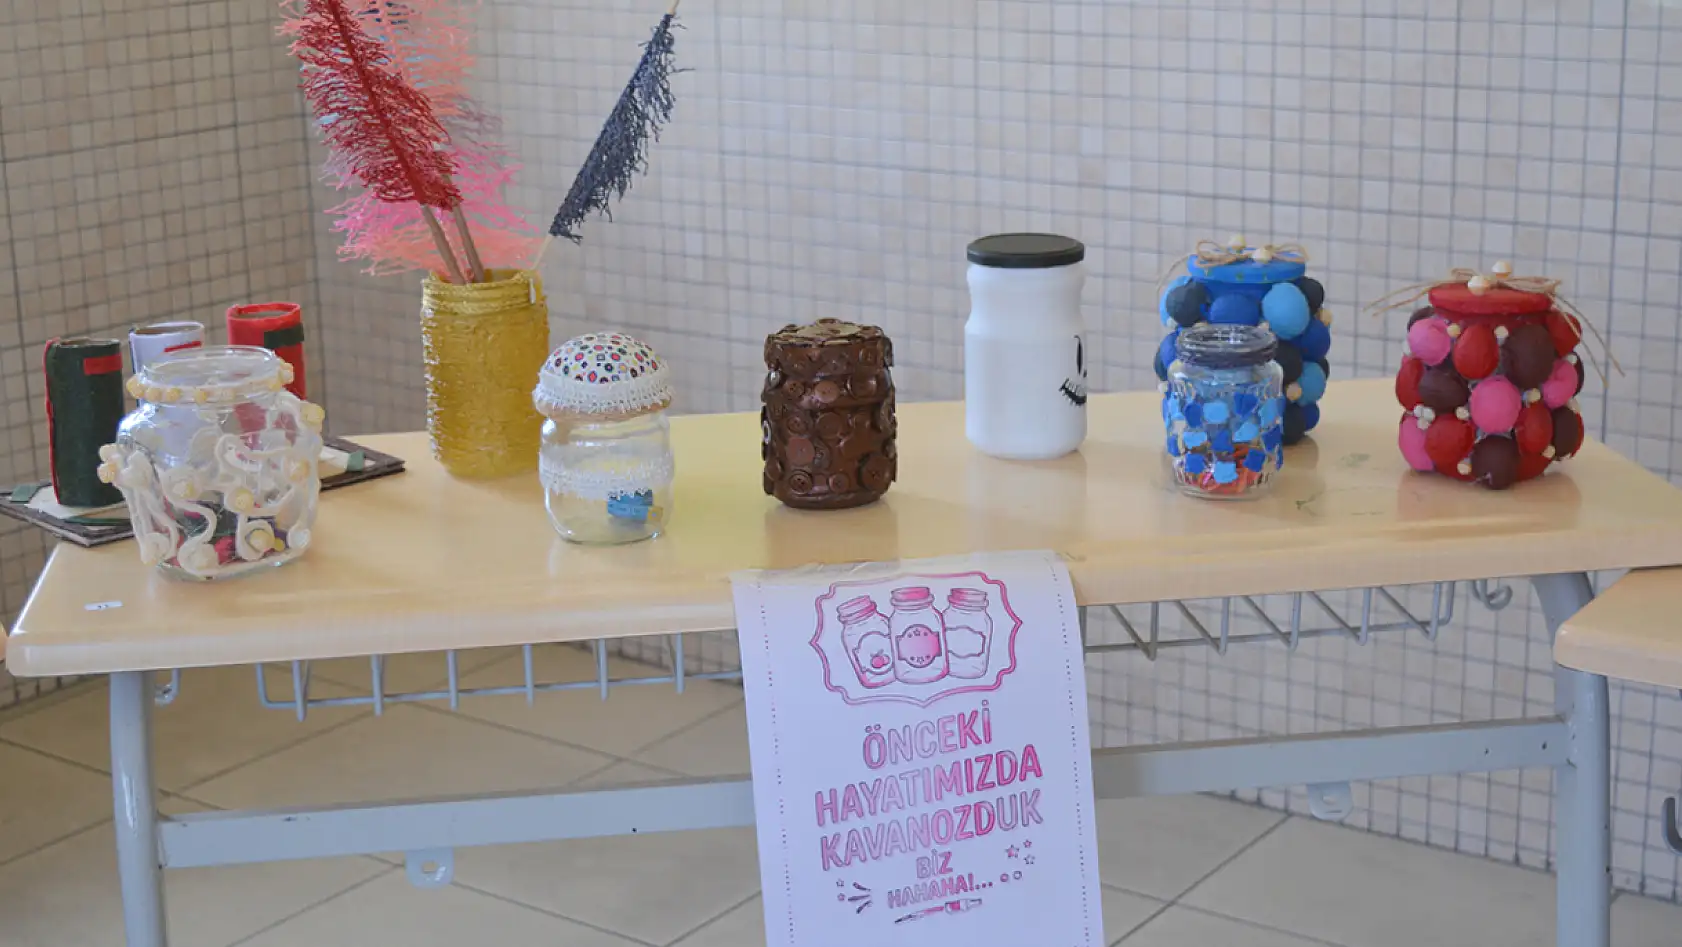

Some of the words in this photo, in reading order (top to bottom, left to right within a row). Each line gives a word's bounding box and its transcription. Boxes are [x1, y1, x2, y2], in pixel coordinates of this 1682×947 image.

[862, 699, 992, 769] ÖNCEKİ
[814, 744, 1044, 827] HAYATIMIZDA
[819, 788, 1044, 871] KAVANOZDUK
[916, 848, 953, 879] BİZ
